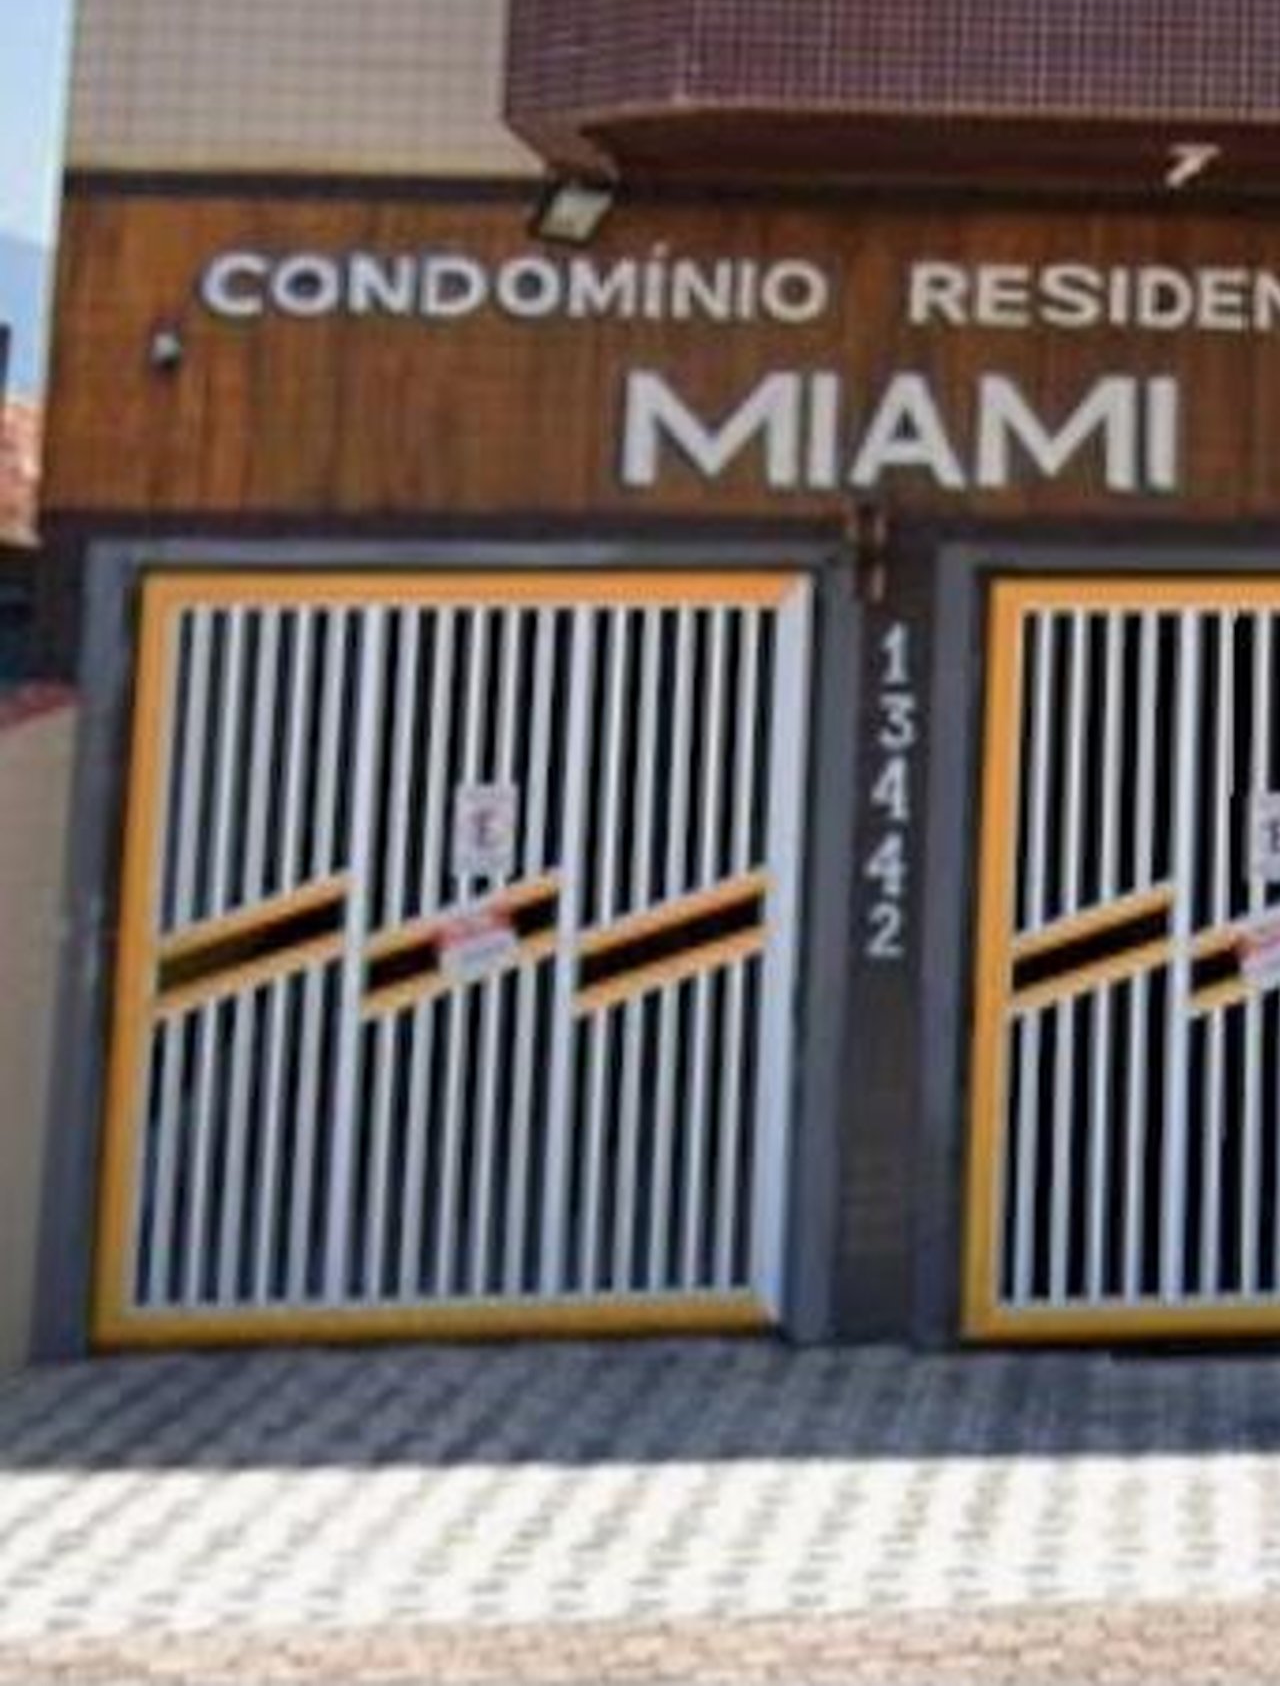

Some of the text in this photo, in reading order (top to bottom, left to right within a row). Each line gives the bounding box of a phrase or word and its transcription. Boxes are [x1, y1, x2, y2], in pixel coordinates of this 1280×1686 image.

[201, 243, 828, 323] CONDOMÍNIO
[619, 366, 1179, 491] MIAMI
[862, 622, 916, 960] 13442
